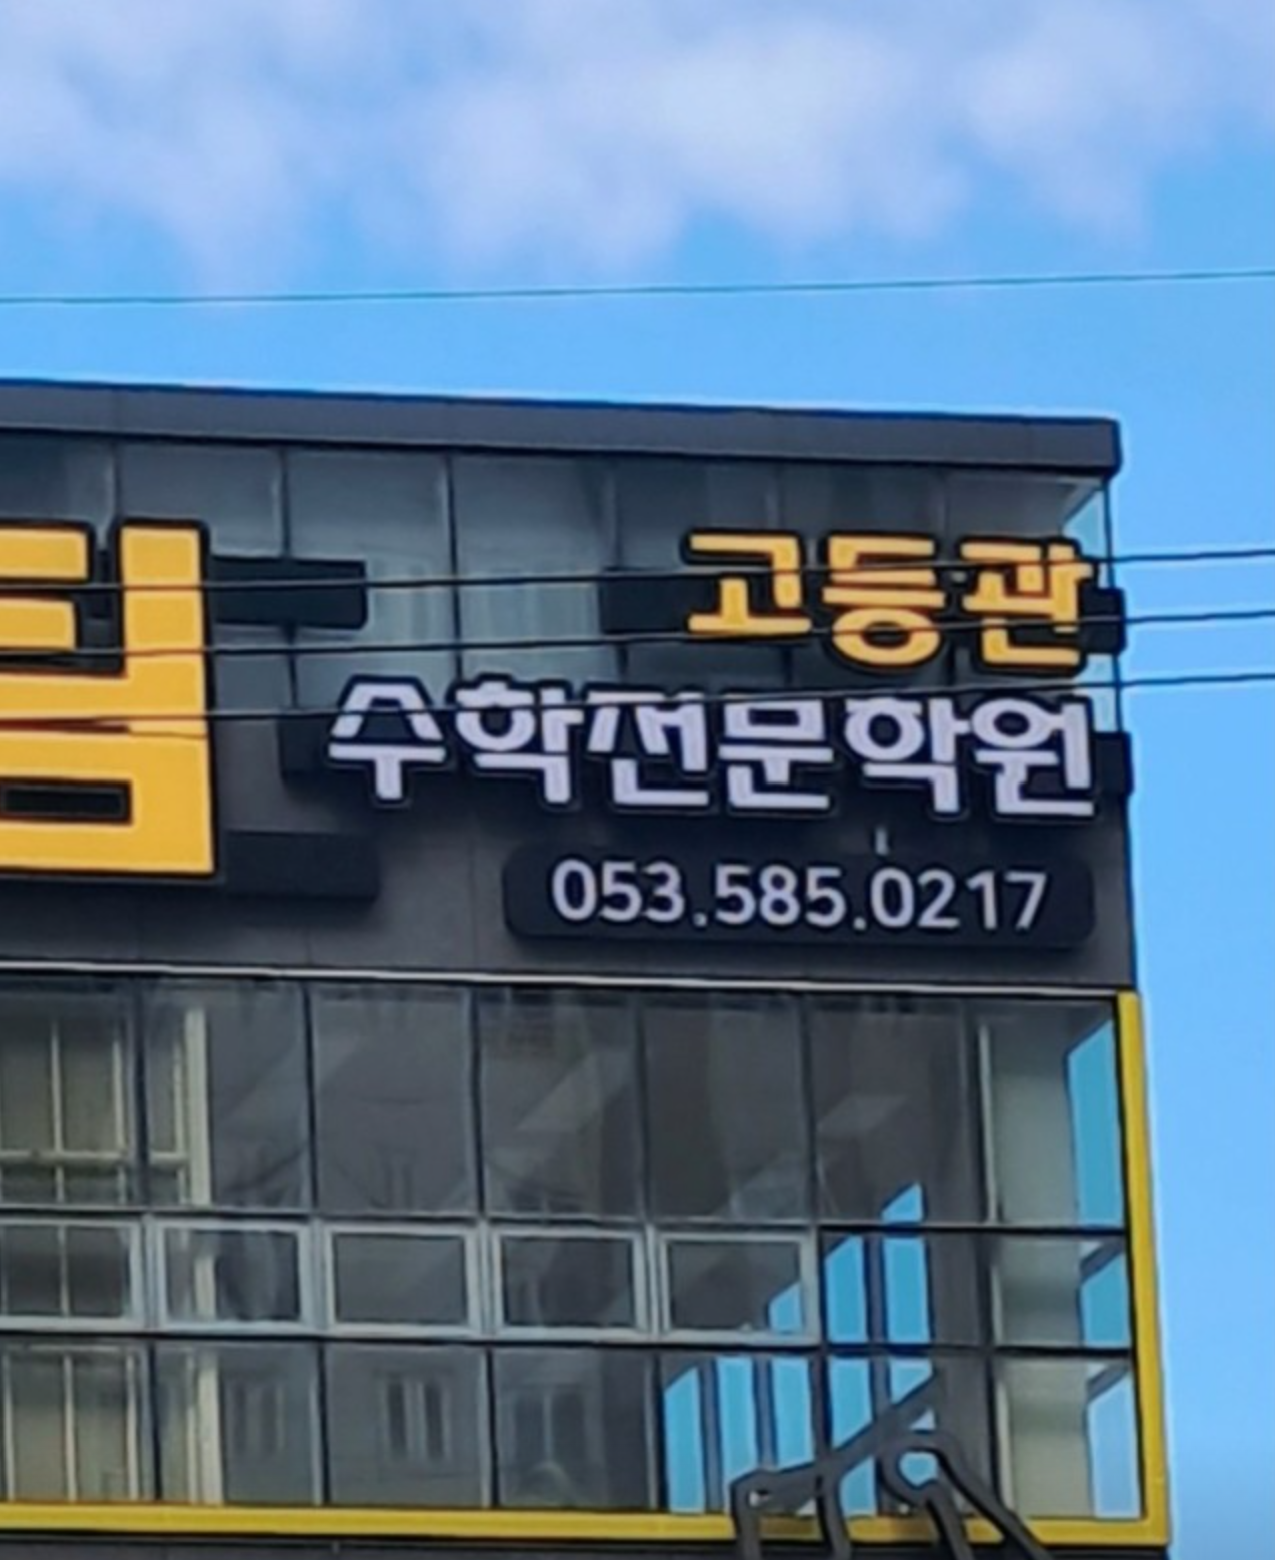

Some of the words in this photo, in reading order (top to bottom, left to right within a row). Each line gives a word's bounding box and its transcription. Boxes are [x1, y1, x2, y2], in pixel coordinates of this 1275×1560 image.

[686, 532, 1094, 667] 고등관
[328, 681, 1097, 818] 수학전문학원
[551, 859, 1048, 931] 053.585.0217
